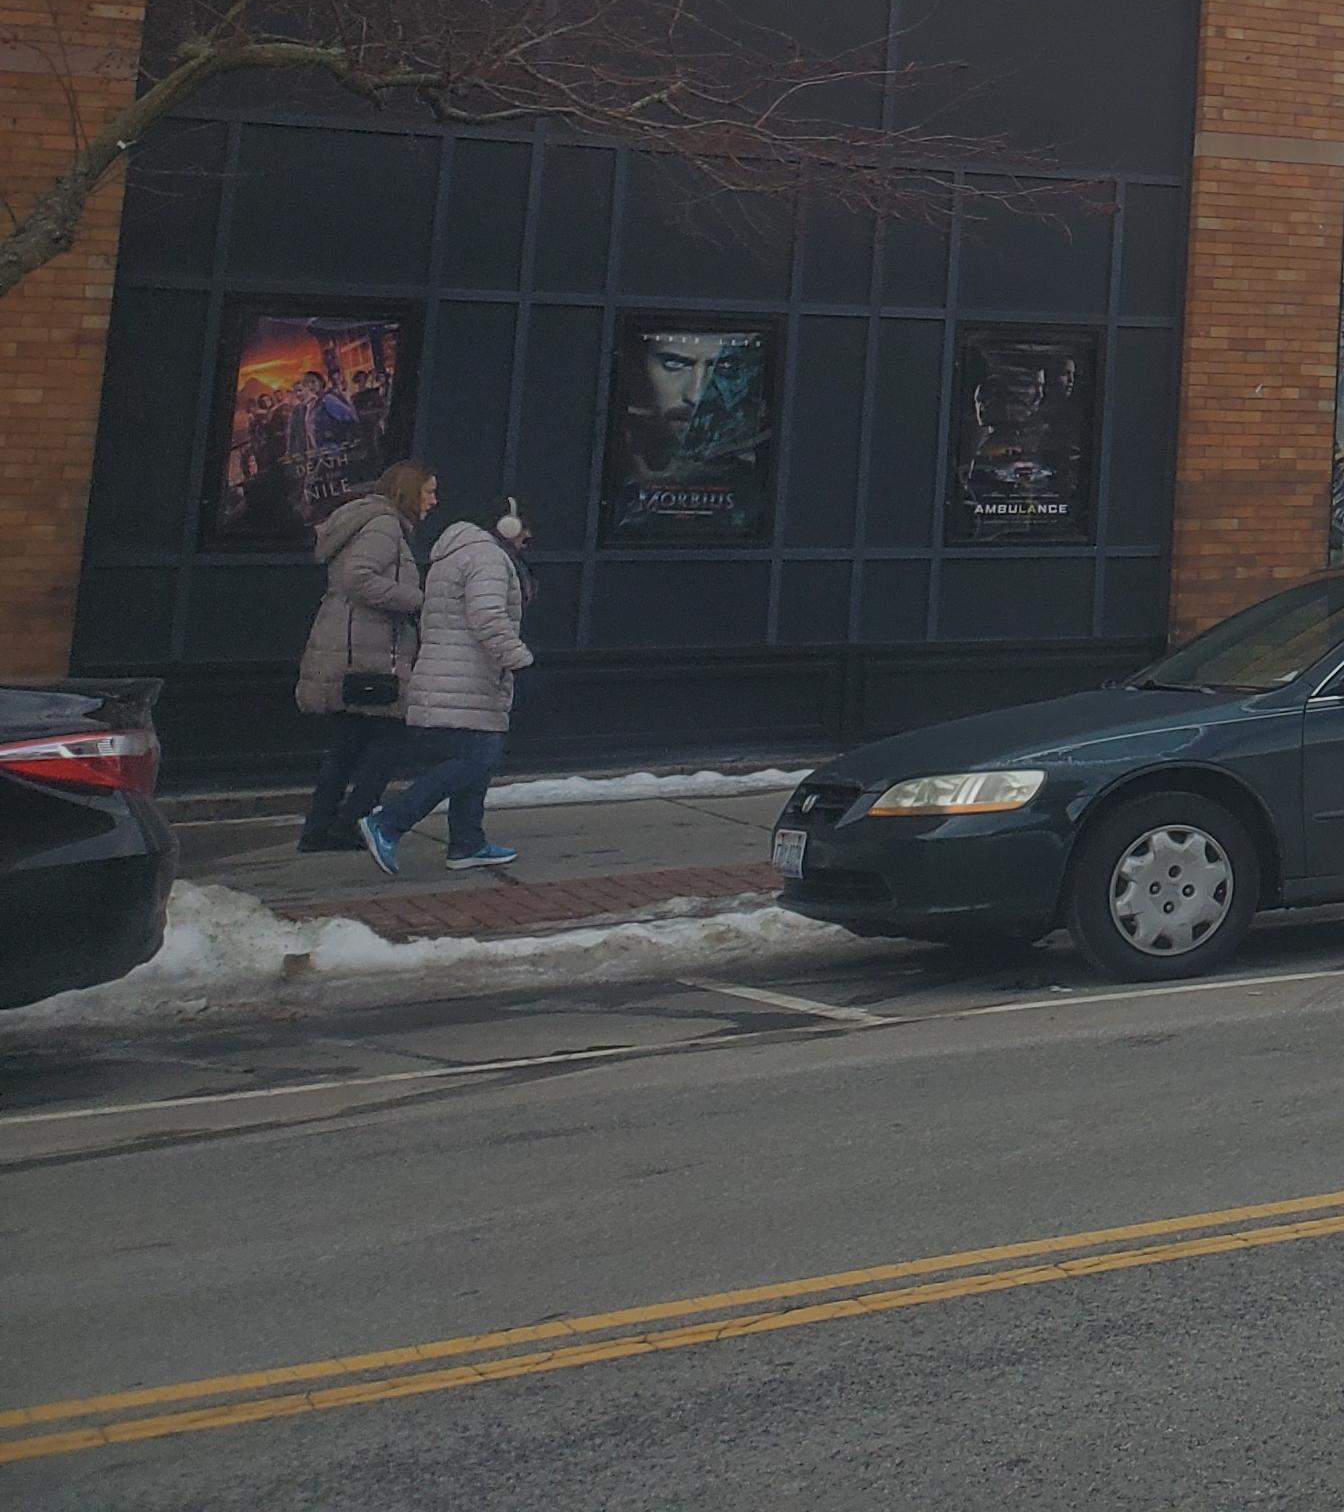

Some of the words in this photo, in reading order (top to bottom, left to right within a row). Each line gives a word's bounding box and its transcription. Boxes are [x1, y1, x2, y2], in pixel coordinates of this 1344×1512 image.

[296, 453, 350, 477] DEATH
[304, 479, 352, 502] NILE
[638, 490, 736, 510] MORBIUS
[974, 504, 1069, 515] AMBULANCE
